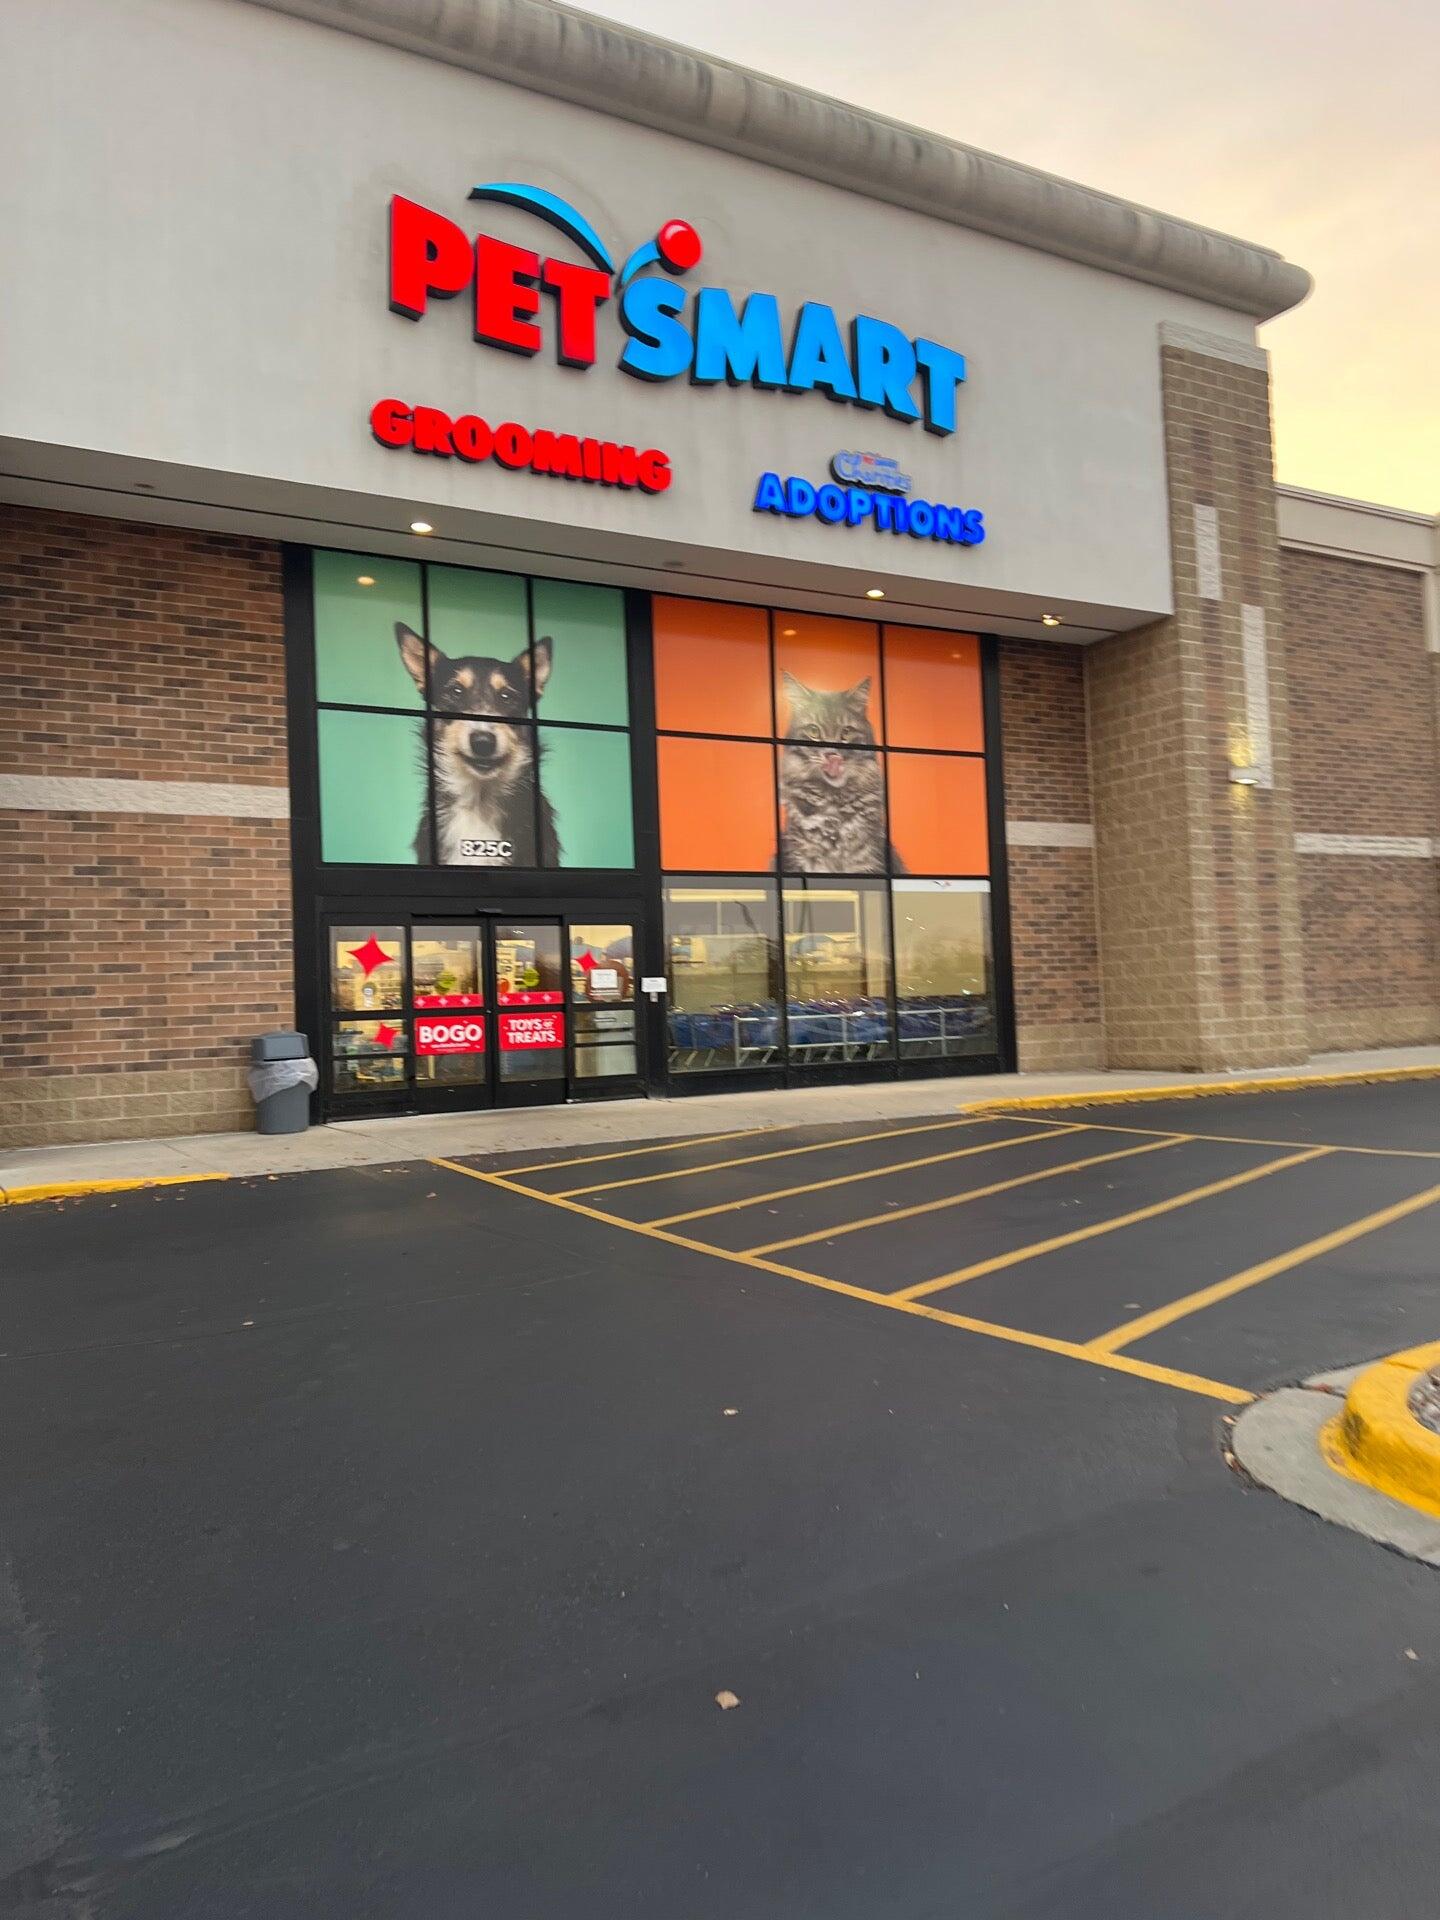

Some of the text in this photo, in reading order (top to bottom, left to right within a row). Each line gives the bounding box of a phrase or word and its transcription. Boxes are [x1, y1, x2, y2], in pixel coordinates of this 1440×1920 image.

[371, 399, 672, 493] GROOMING
[755, 472, 985, 545] ADOPTIONS
[461, 840, 513, 857] 825C
[419, 1024, 483, 1043] BOGO
[508, 1018, 542, 1031] TOYS
[506, 1030, 556, 1044] TREATS
